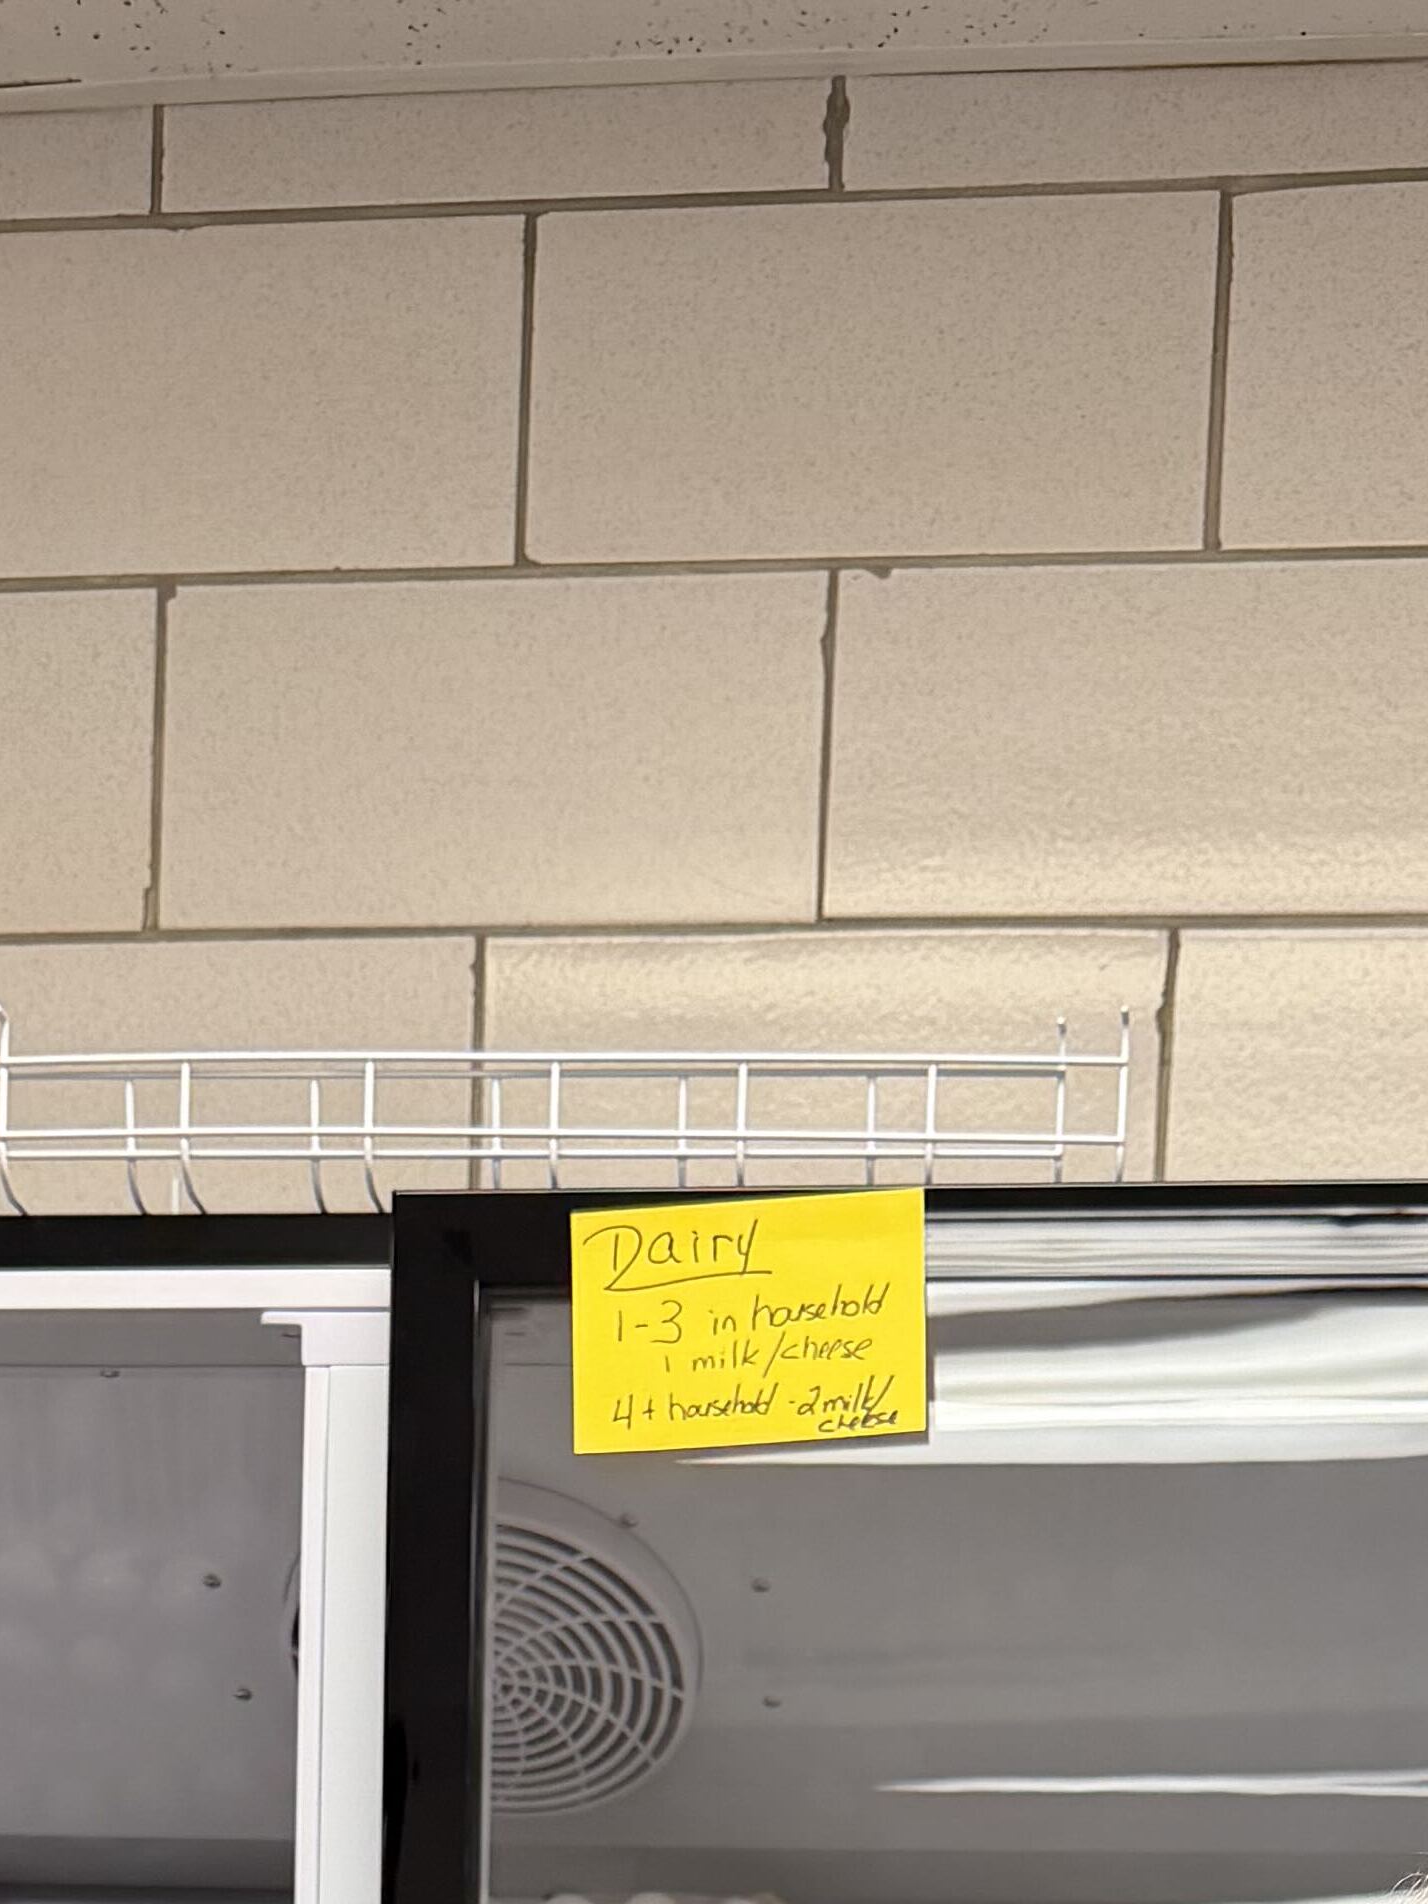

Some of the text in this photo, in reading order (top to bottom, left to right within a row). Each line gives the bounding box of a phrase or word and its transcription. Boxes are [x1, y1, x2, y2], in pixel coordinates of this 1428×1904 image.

[582, 1218, 760, 1291] Dairy
[707, 1309, 737, 1336] in
[751, 1282, 891, 1332] household
[664, 1355, 671, 1373] 1
[668, 1382, 779, 1423] household
[818, 1409, 900, 1434] cheese
